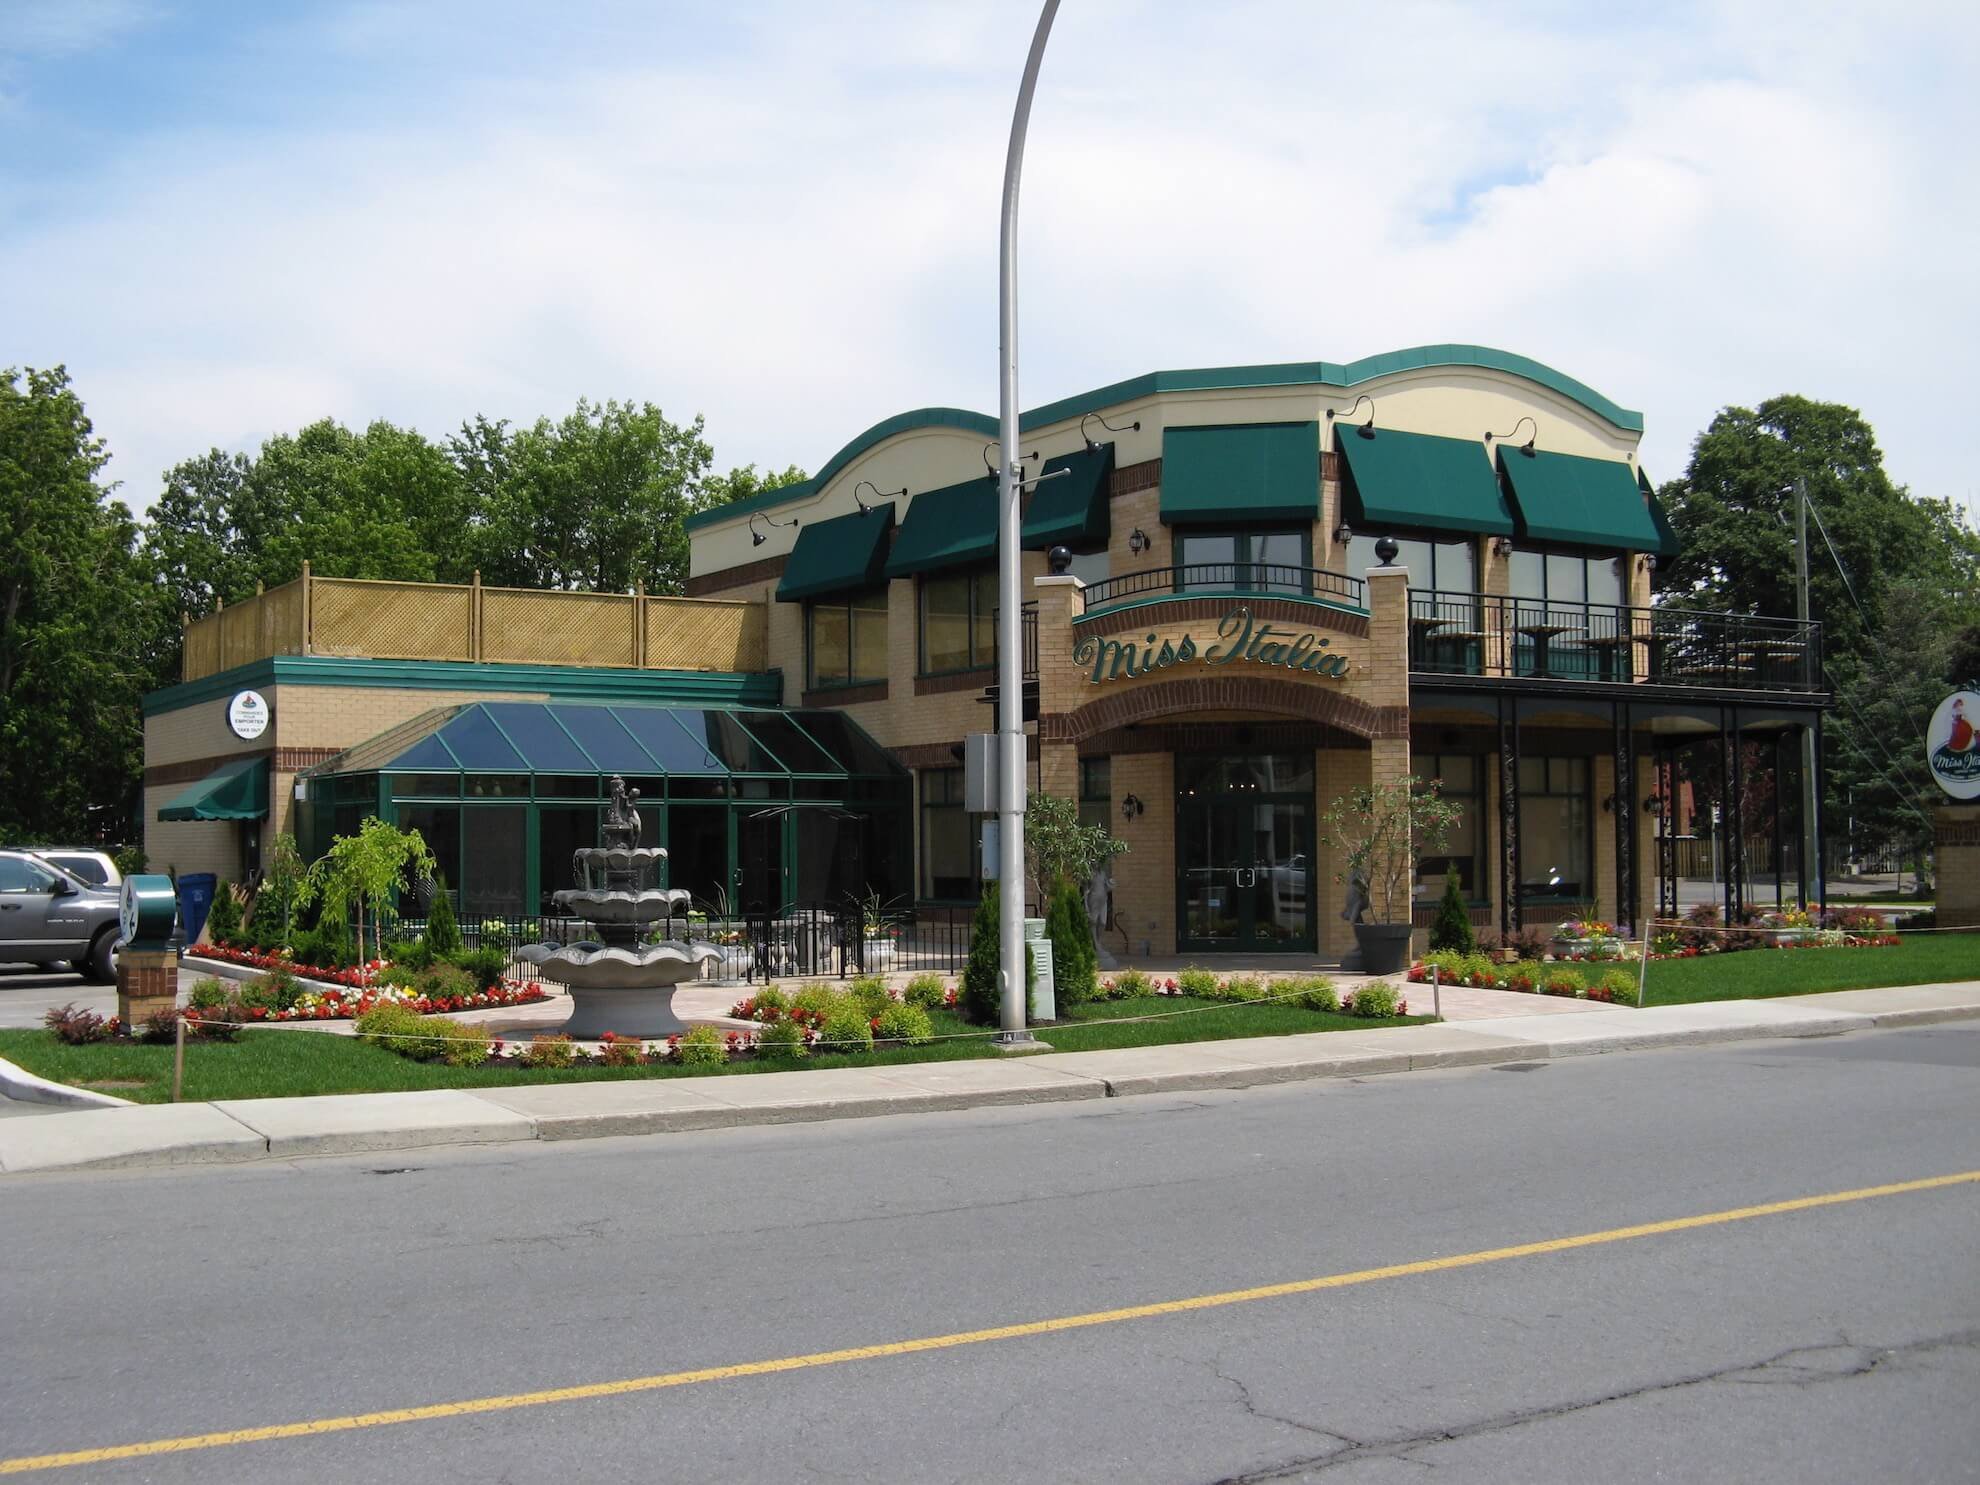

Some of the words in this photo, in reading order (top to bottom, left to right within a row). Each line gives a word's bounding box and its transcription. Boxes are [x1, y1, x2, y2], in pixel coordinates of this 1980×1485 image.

[1072, 634, 1197, 684] Miss
[1204, 606, 1350, 678] Italia
[1933, 754, 1962, 769] Miss
